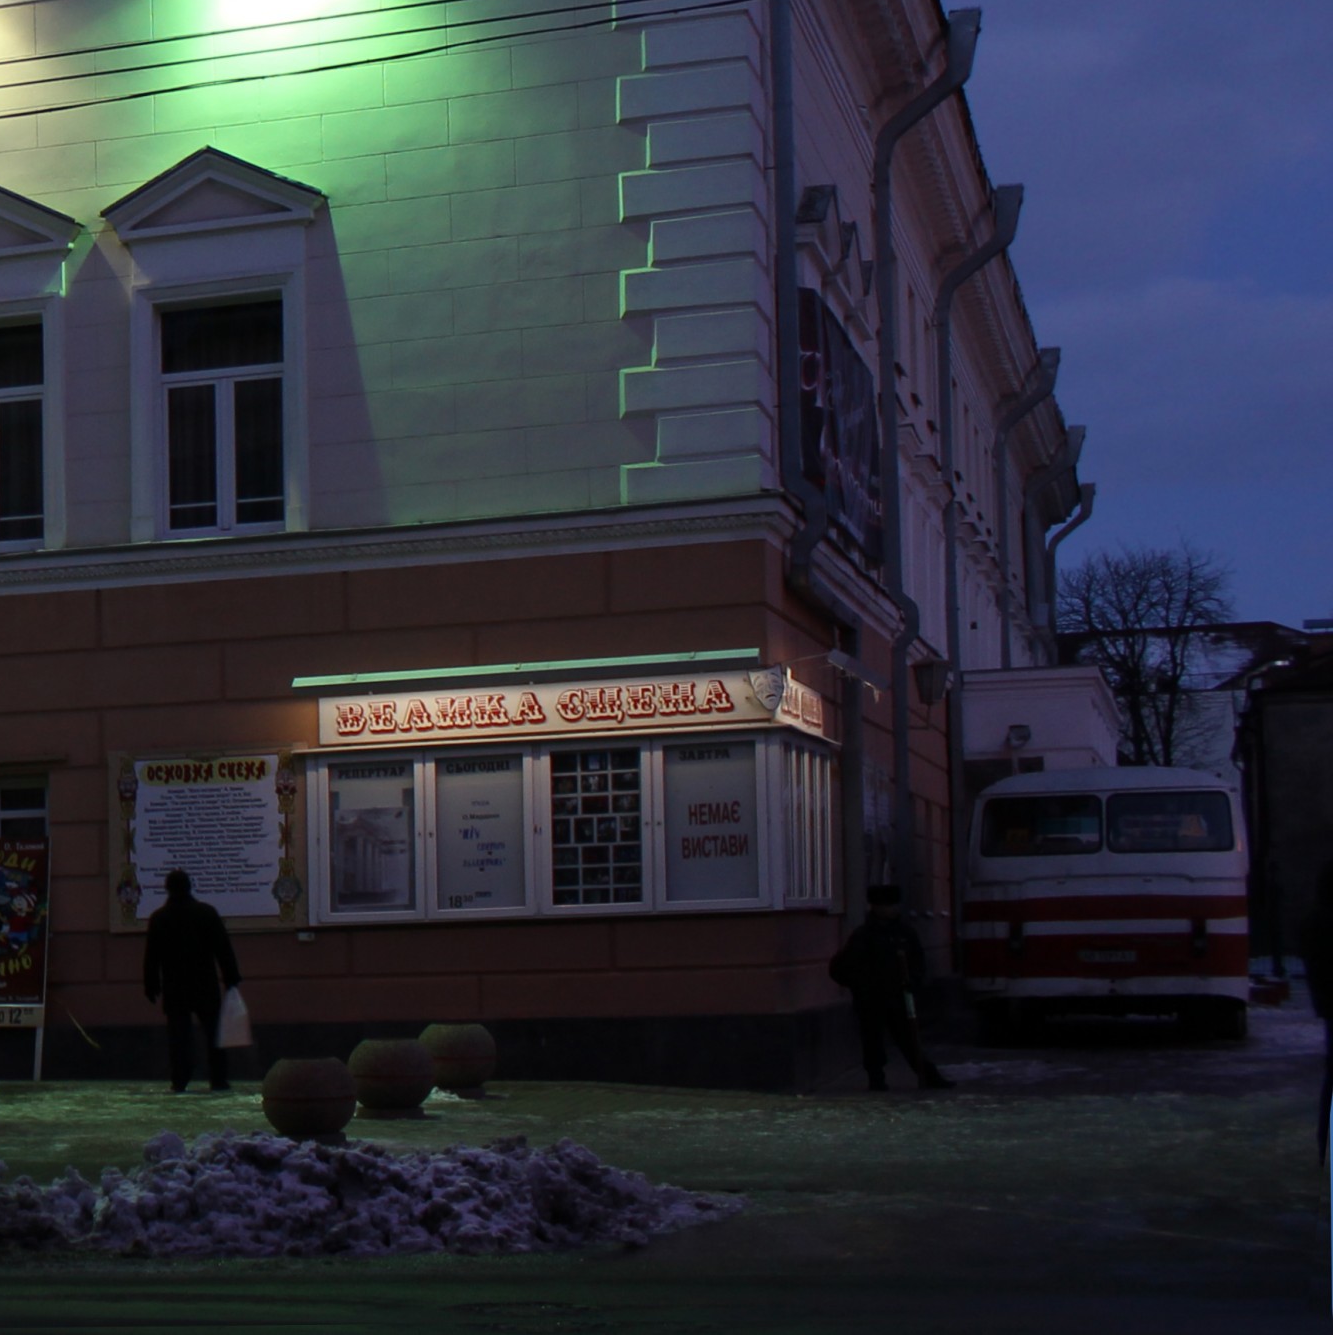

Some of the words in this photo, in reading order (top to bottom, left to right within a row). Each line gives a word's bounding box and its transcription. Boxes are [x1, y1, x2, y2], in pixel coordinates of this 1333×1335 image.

[335, 692, 545, 736] ВЕЛИКА
[555, 679, 734, 722] СЦЕНА
[446, 760, 511, 773] СЬОГОДНІ
[678, 749, 731, 761] ЗАВТРА
[147, 763, 213, 783] ОСНОВНА
[218, 760, 266, 781] СЦЕНА
[339, 767, 406, 780] РЕПЕРТУАР
[687, 801, 742, 825] НЕМАЄ
[682, 835, 750, 859] ВИСТАВИ
